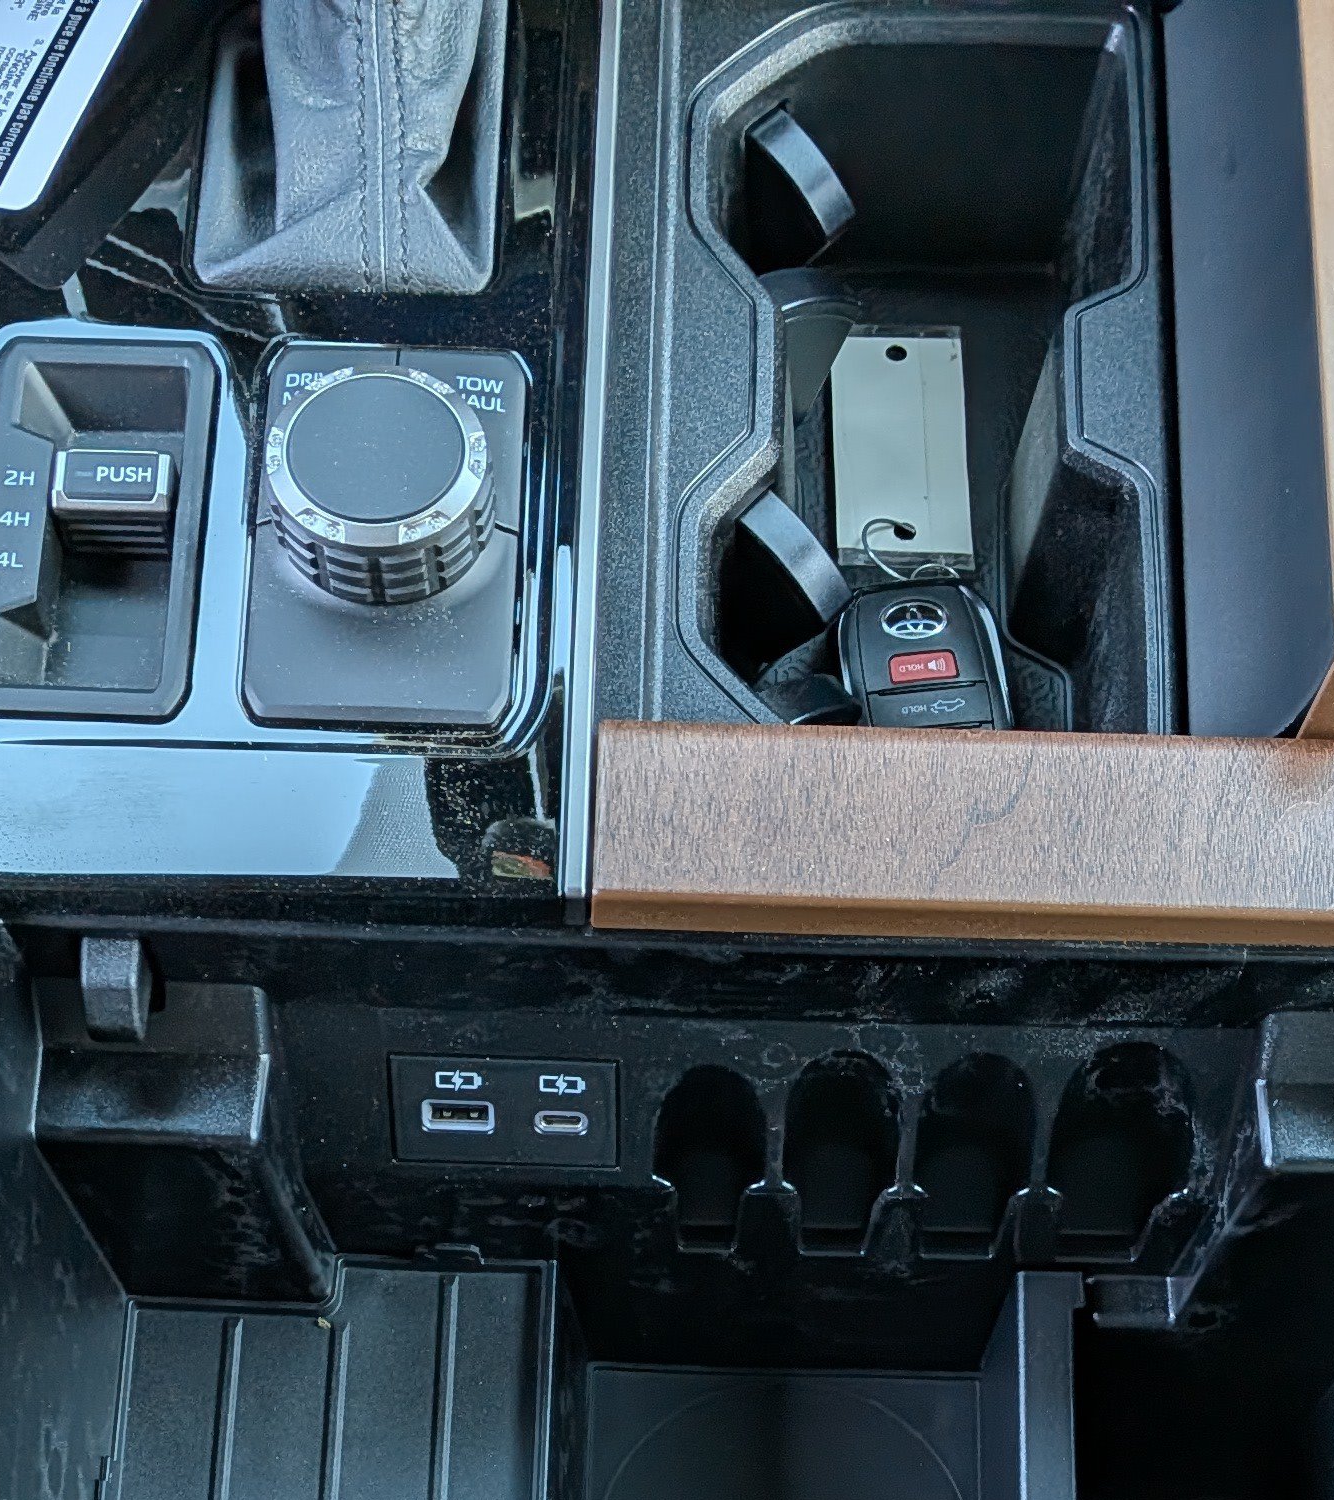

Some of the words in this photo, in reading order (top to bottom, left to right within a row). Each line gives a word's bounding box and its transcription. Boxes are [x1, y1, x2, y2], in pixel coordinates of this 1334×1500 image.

[13, 102, 34, 120] pas
[455, 375, 505, 394] TOW
[461, 392, 506, 413] AUL
[3, 470, 36, 486] 2H
[95, 466, 152, 483] PUSH
[898, 662, 925, 673] HOLD
[901, 705, 927, 715] HOLD
